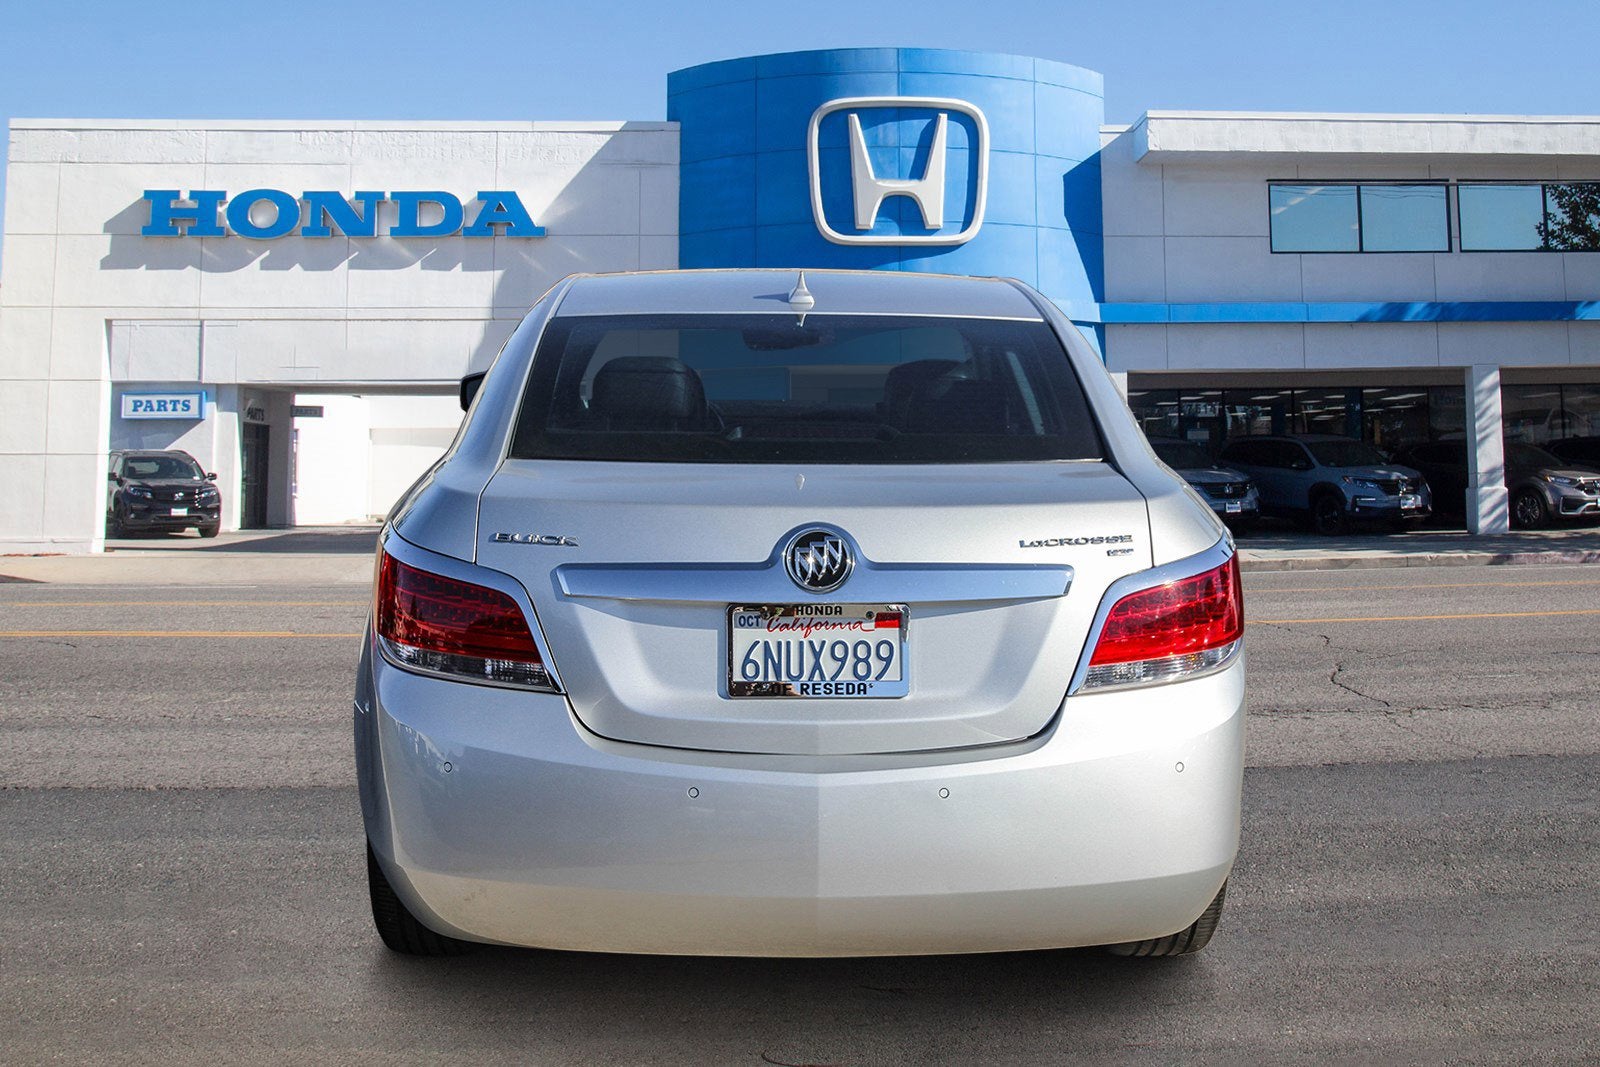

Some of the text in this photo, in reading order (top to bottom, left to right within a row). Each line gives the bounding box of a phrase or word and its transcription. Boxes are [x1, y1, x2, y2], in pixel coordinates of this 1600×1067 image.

[141, 189, 547, 239] HONDA
[131, 399, 191, 413] PARTS
[796, 605, 842, 616] HONDA
[738, 615, 760, 627] OCT
[767, 616, 874, 638] California
[740, 640, 894, 681] 6NUX989
